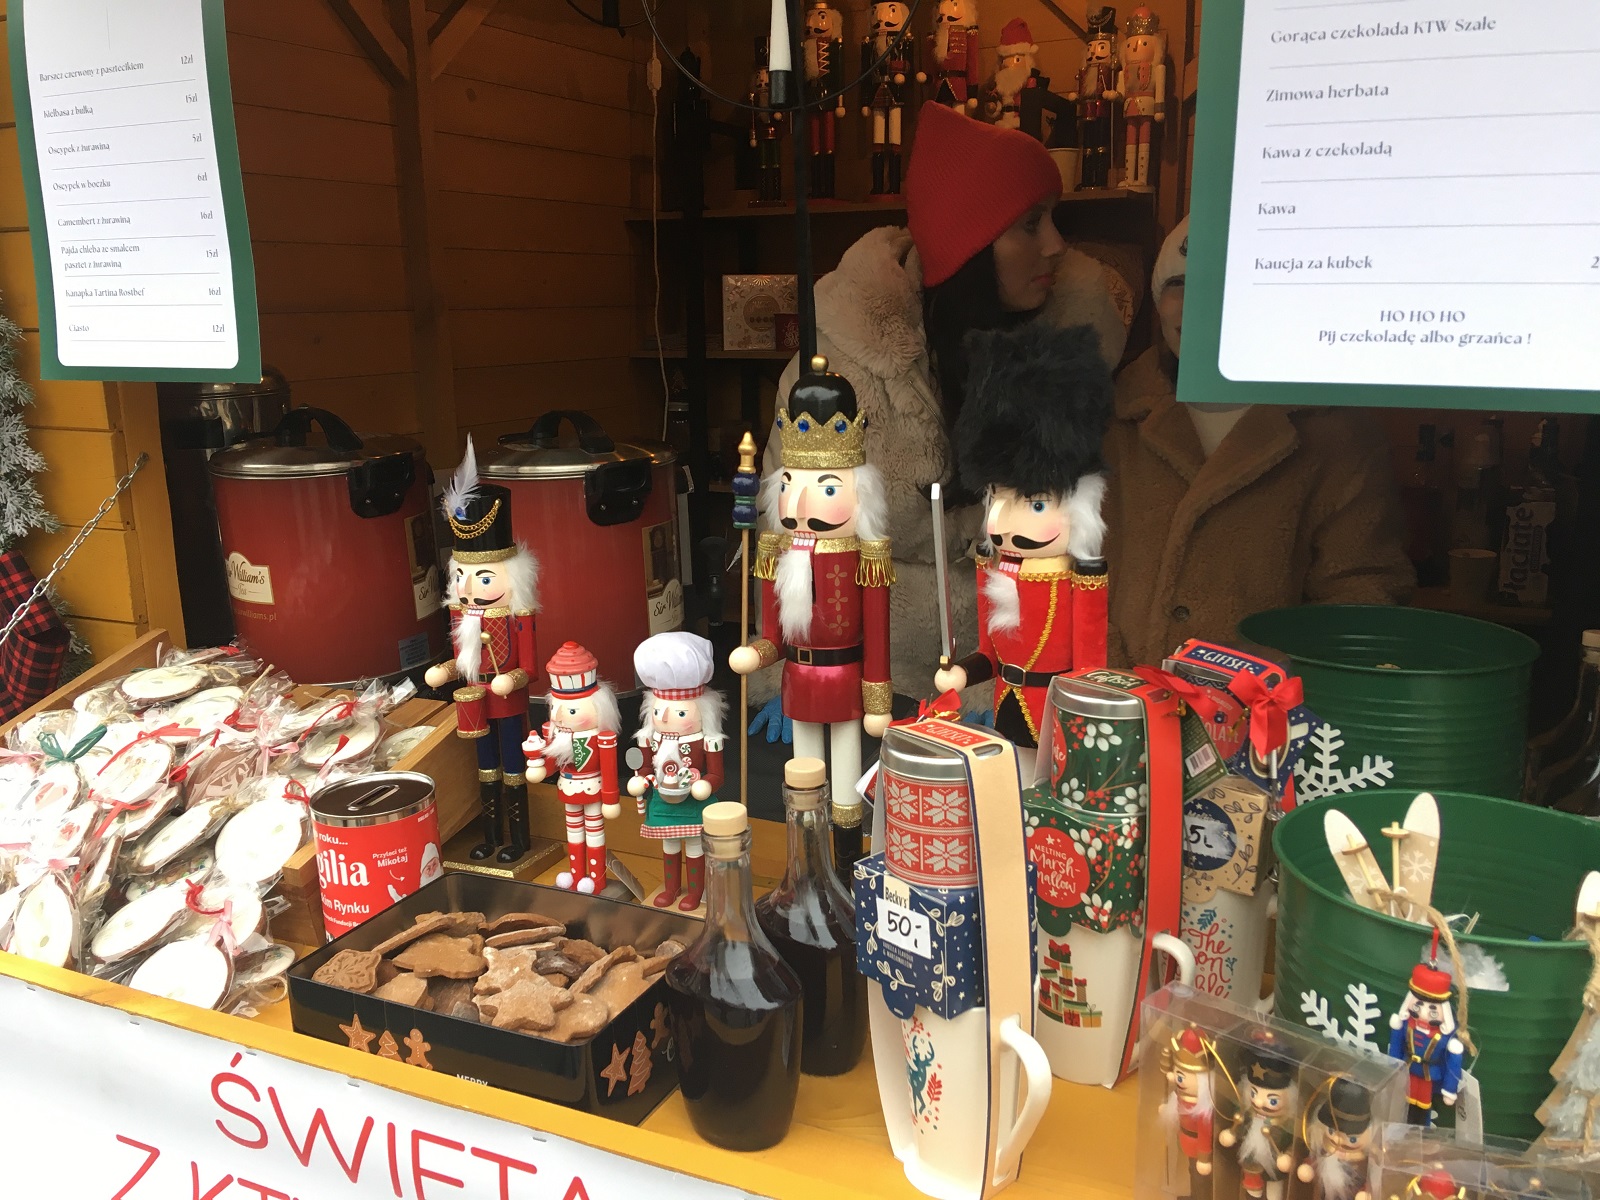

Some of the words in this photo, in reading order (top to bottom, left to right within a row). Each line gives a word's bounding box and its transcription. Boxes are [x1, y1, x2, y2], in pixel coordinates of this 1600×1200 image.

[1270, 28, 1327, 45] Gorąca
[1330, 21, 1409, 40] czekolada
[1413, 19, 1452, 35] KTW
[39, 71, 64, 82] Barszcz
[64, 67, 94, 79] czerwony
[1265, 87, 1324, 103] Zimowa
[1327, 83, 1390, 99] herbata
[47, 144, 76, 156] Oscypek
[1262, 145, 1301, 159] Kawa
[1304, 147, 1312, 158] z
[1315, 141, 1393, 158] czekoladą
[52, 180, 81, 192] Oscypek
[1257, 202, 1297, 216] Kawa
[57, 217, 96, 227] Camembert
[61, 245, 79, 257] Pajda
[110, 243, 140, 253] smalcem
[1254, 257, 1304, 273] Kaucja
[1306, 258, 1323, 270] za
[1326, 255, 1373, 270] kubek
[65, 288, 93, 300] Kanapka
[94, 288, 118, 297] Tartina
[1379, 309, 1405, 324] HO
[1408, 309, 1436, 324] HO
[1439, 310, 1466, 324] HO
[68, 324, 90, 332] Ciasto
[1318, 329, 1337, 346] Pij
[1339, 329, 1416, 346] czekoladę
[1419, 330, 1455, 344] albo
[1458, 331, 1523, 348] grzańca
[1526, 332, 1532, 345] !
[231, 560, 266, 585] William's
[1203, 651, 1253, 670] GIFTSET
[1034, 844, 1067, 861] MELTING
[377, 853, 409, 869] Mikołaj
[333, 898, 370, 917] Rynku
